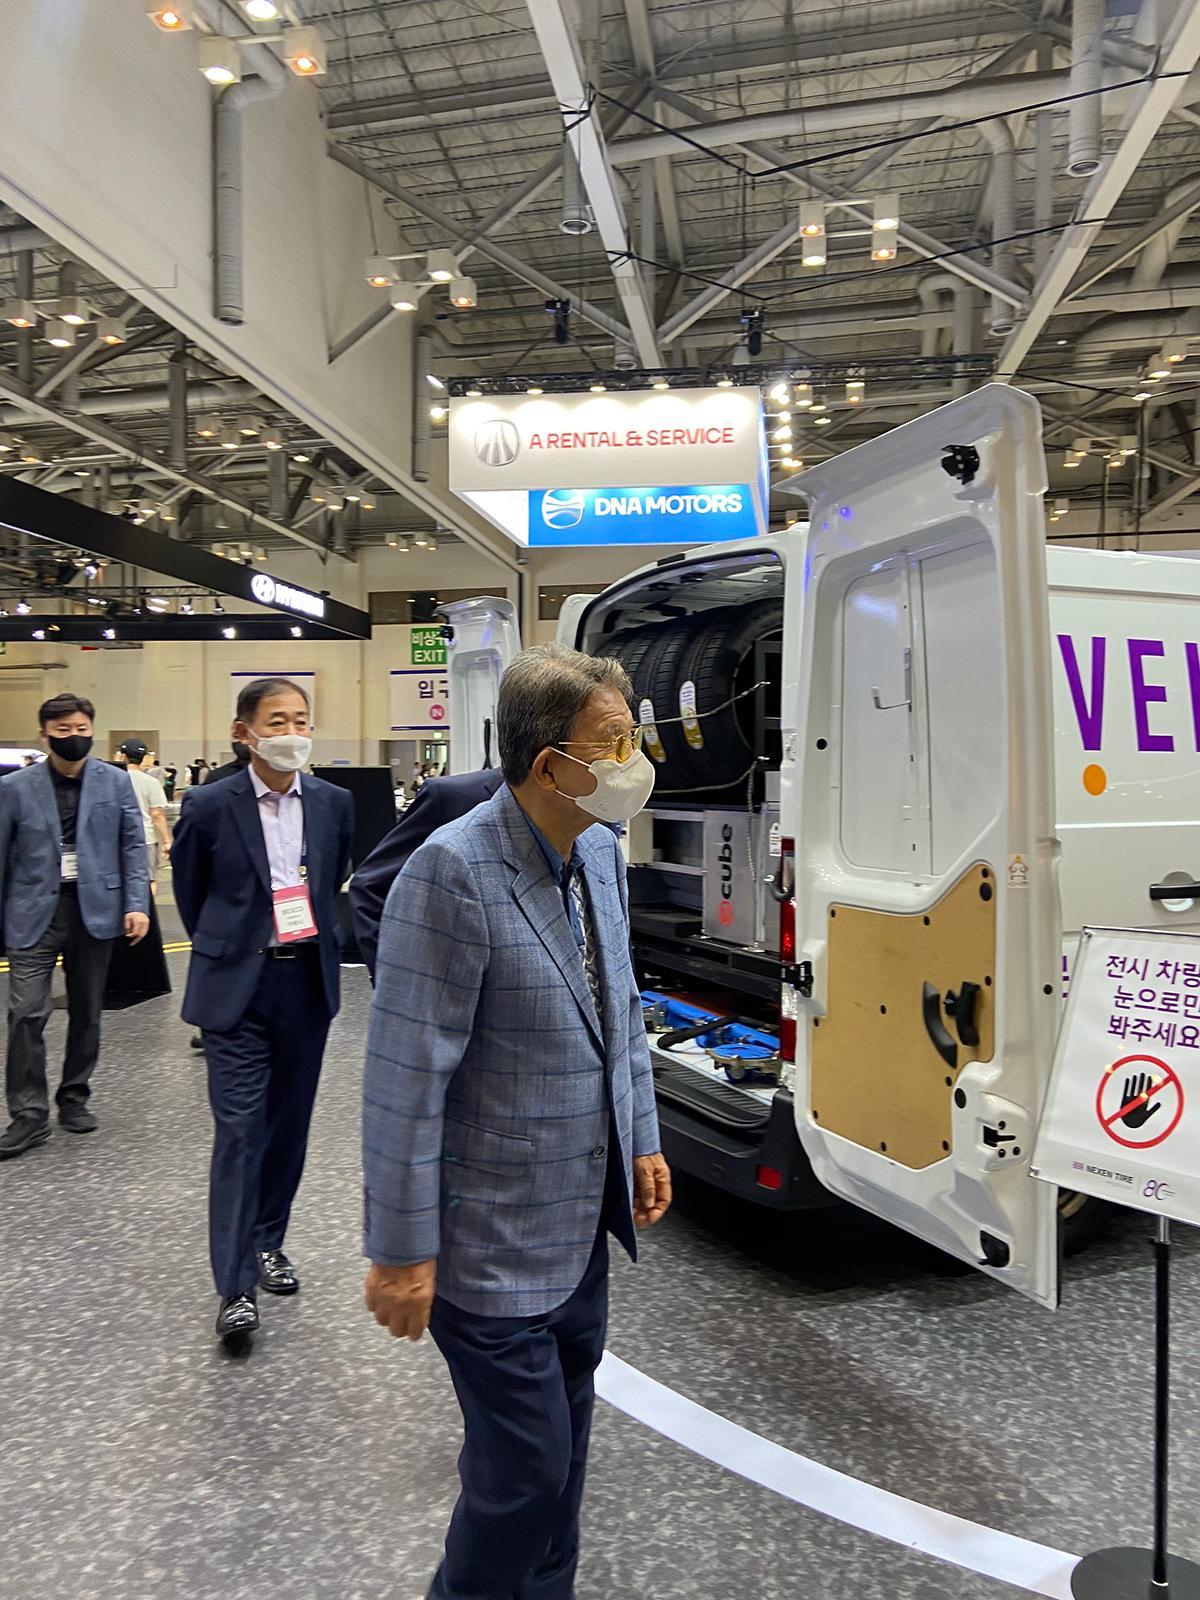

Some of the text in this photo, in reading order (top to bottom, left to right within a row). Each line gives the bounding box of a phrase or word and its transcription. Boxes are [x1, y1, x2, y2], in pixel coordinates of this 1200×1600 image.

[529, 427, 735, 449] A RENTAL & SERVICE
[594, 493, 743, 516] DNA MOTORS
[414, 649, 445, 662] EXIT
[718, 823, 733, 899] cube
[1106, 954, 1149, 981] 전시
[1107, 1015, 1200, 1048] 봐주세요
[1086, 1165, 1113, 1179] NEXEN
[1114, 1172, 1134, 1185] TIRE
